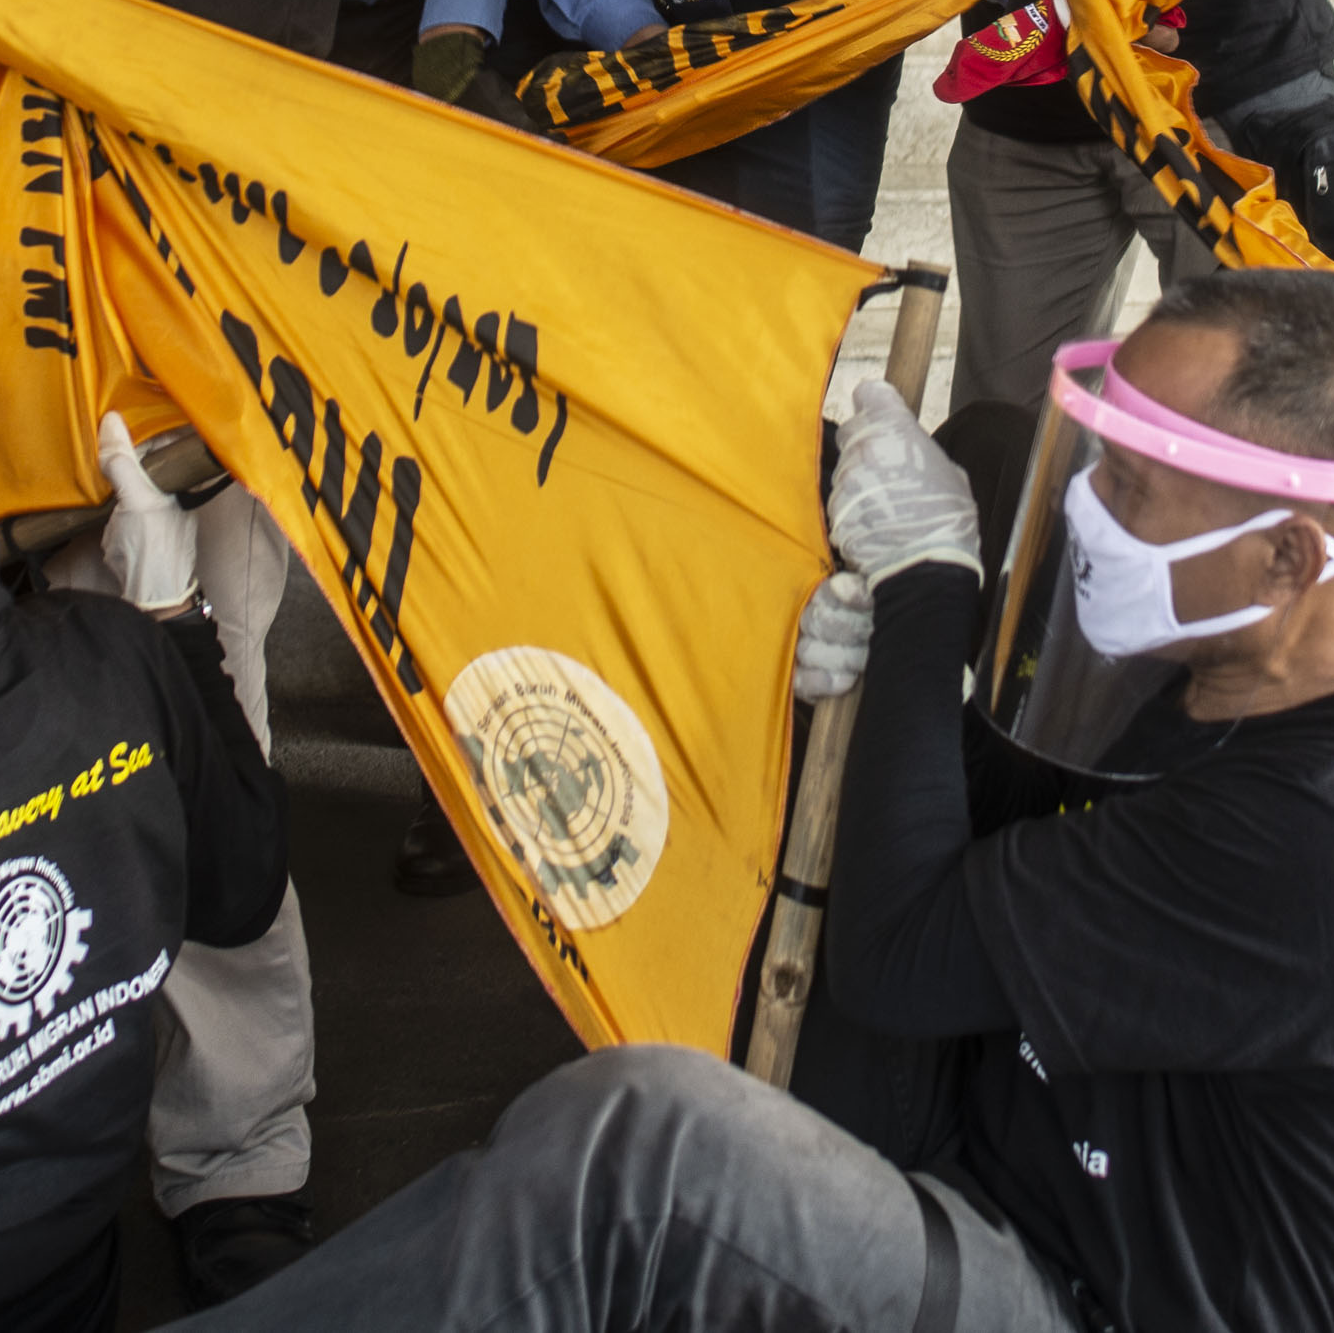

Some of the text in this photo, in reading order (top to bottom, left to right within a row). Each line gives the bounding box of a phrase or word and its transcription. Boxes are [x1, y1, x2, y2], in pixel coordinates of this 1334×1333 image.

[71, 758, 105, 799] at
[109, 741, 154, 785] Sea
[27, 995, 97, 1061] MIGRAN
